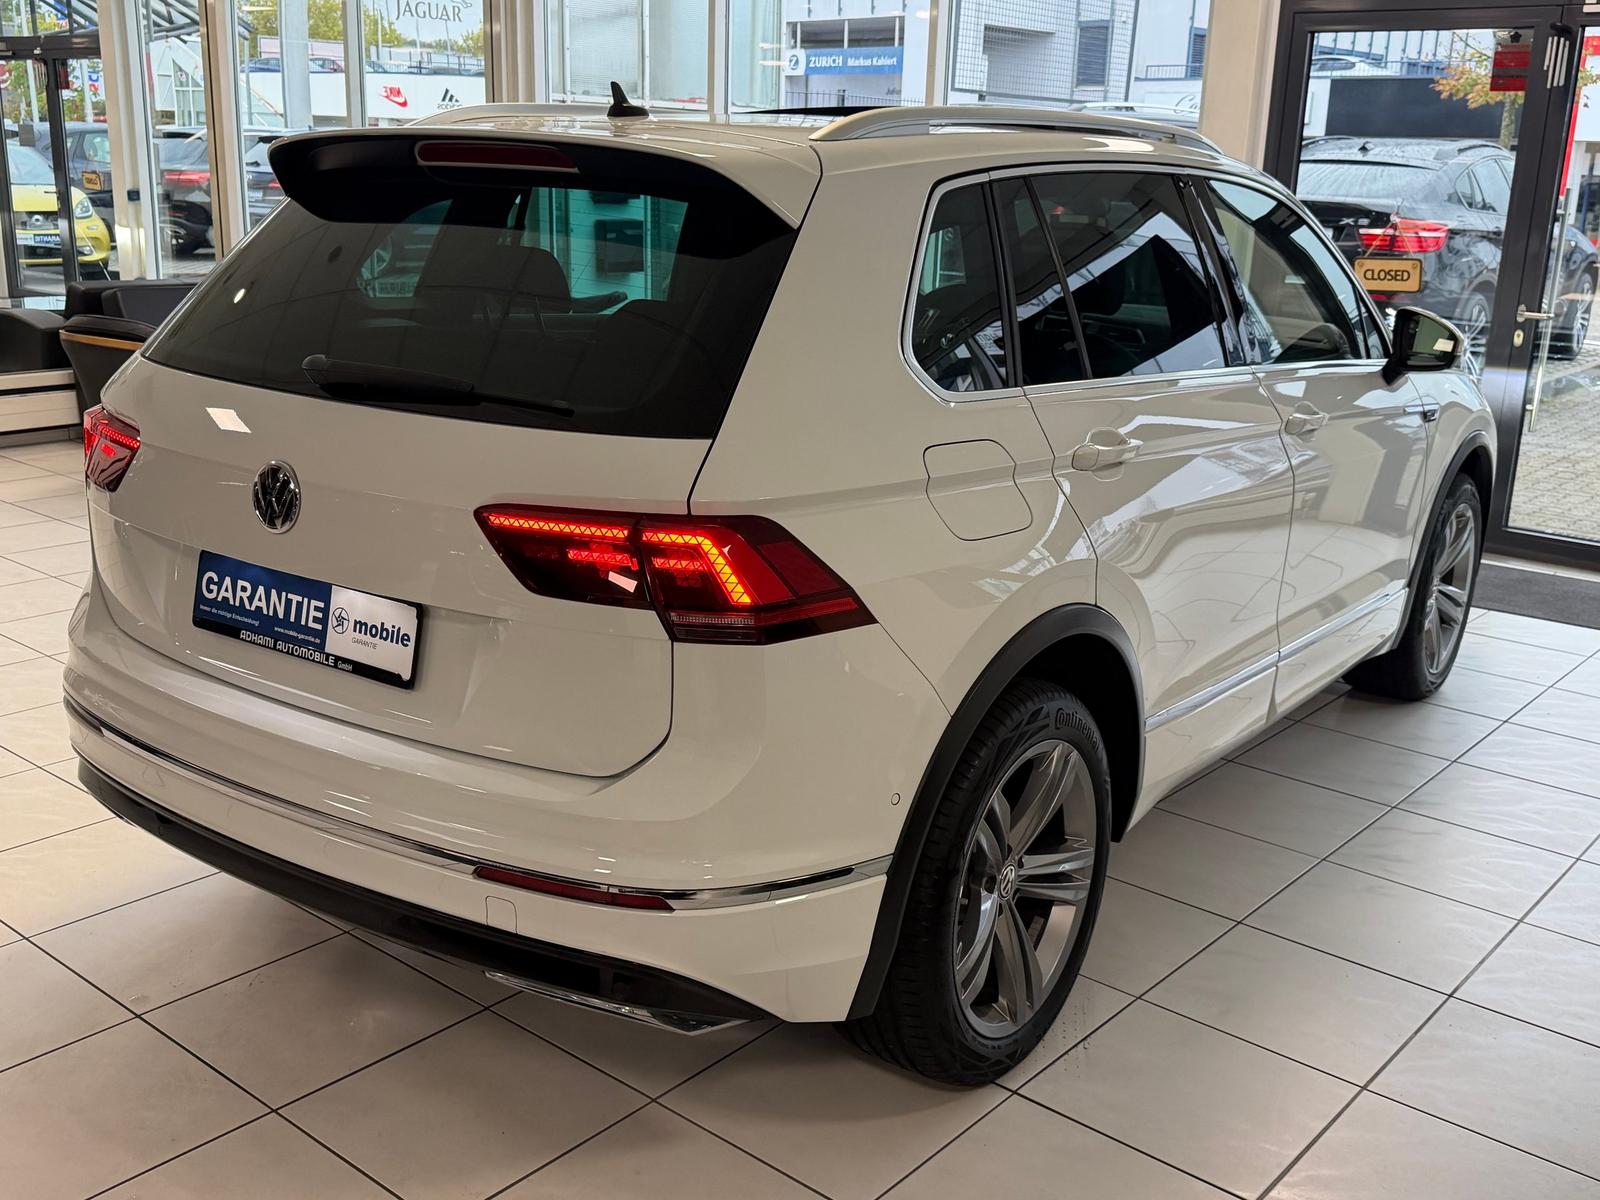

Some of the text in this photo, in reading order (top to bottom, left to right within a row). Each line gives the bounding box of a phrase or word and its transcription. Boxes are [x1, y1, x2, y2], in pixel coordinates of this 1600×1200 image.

[395, 0, 463, 23] JAGUAR
[809, 55, 843, 68] ZURICH
[847, 57, 872, 67] Markus
[1363, 268, 1411, 282] CLOSED
[201, 571, 326, 631] GARANTIE
[351, 636, 379, 650] GARANTIE
[352, 618, 411, 648] mobile
[239, 629, 353, 672] ADHAMI AUTOMOBILE GmbH
[1055, 707, 1100, 754] Continental
